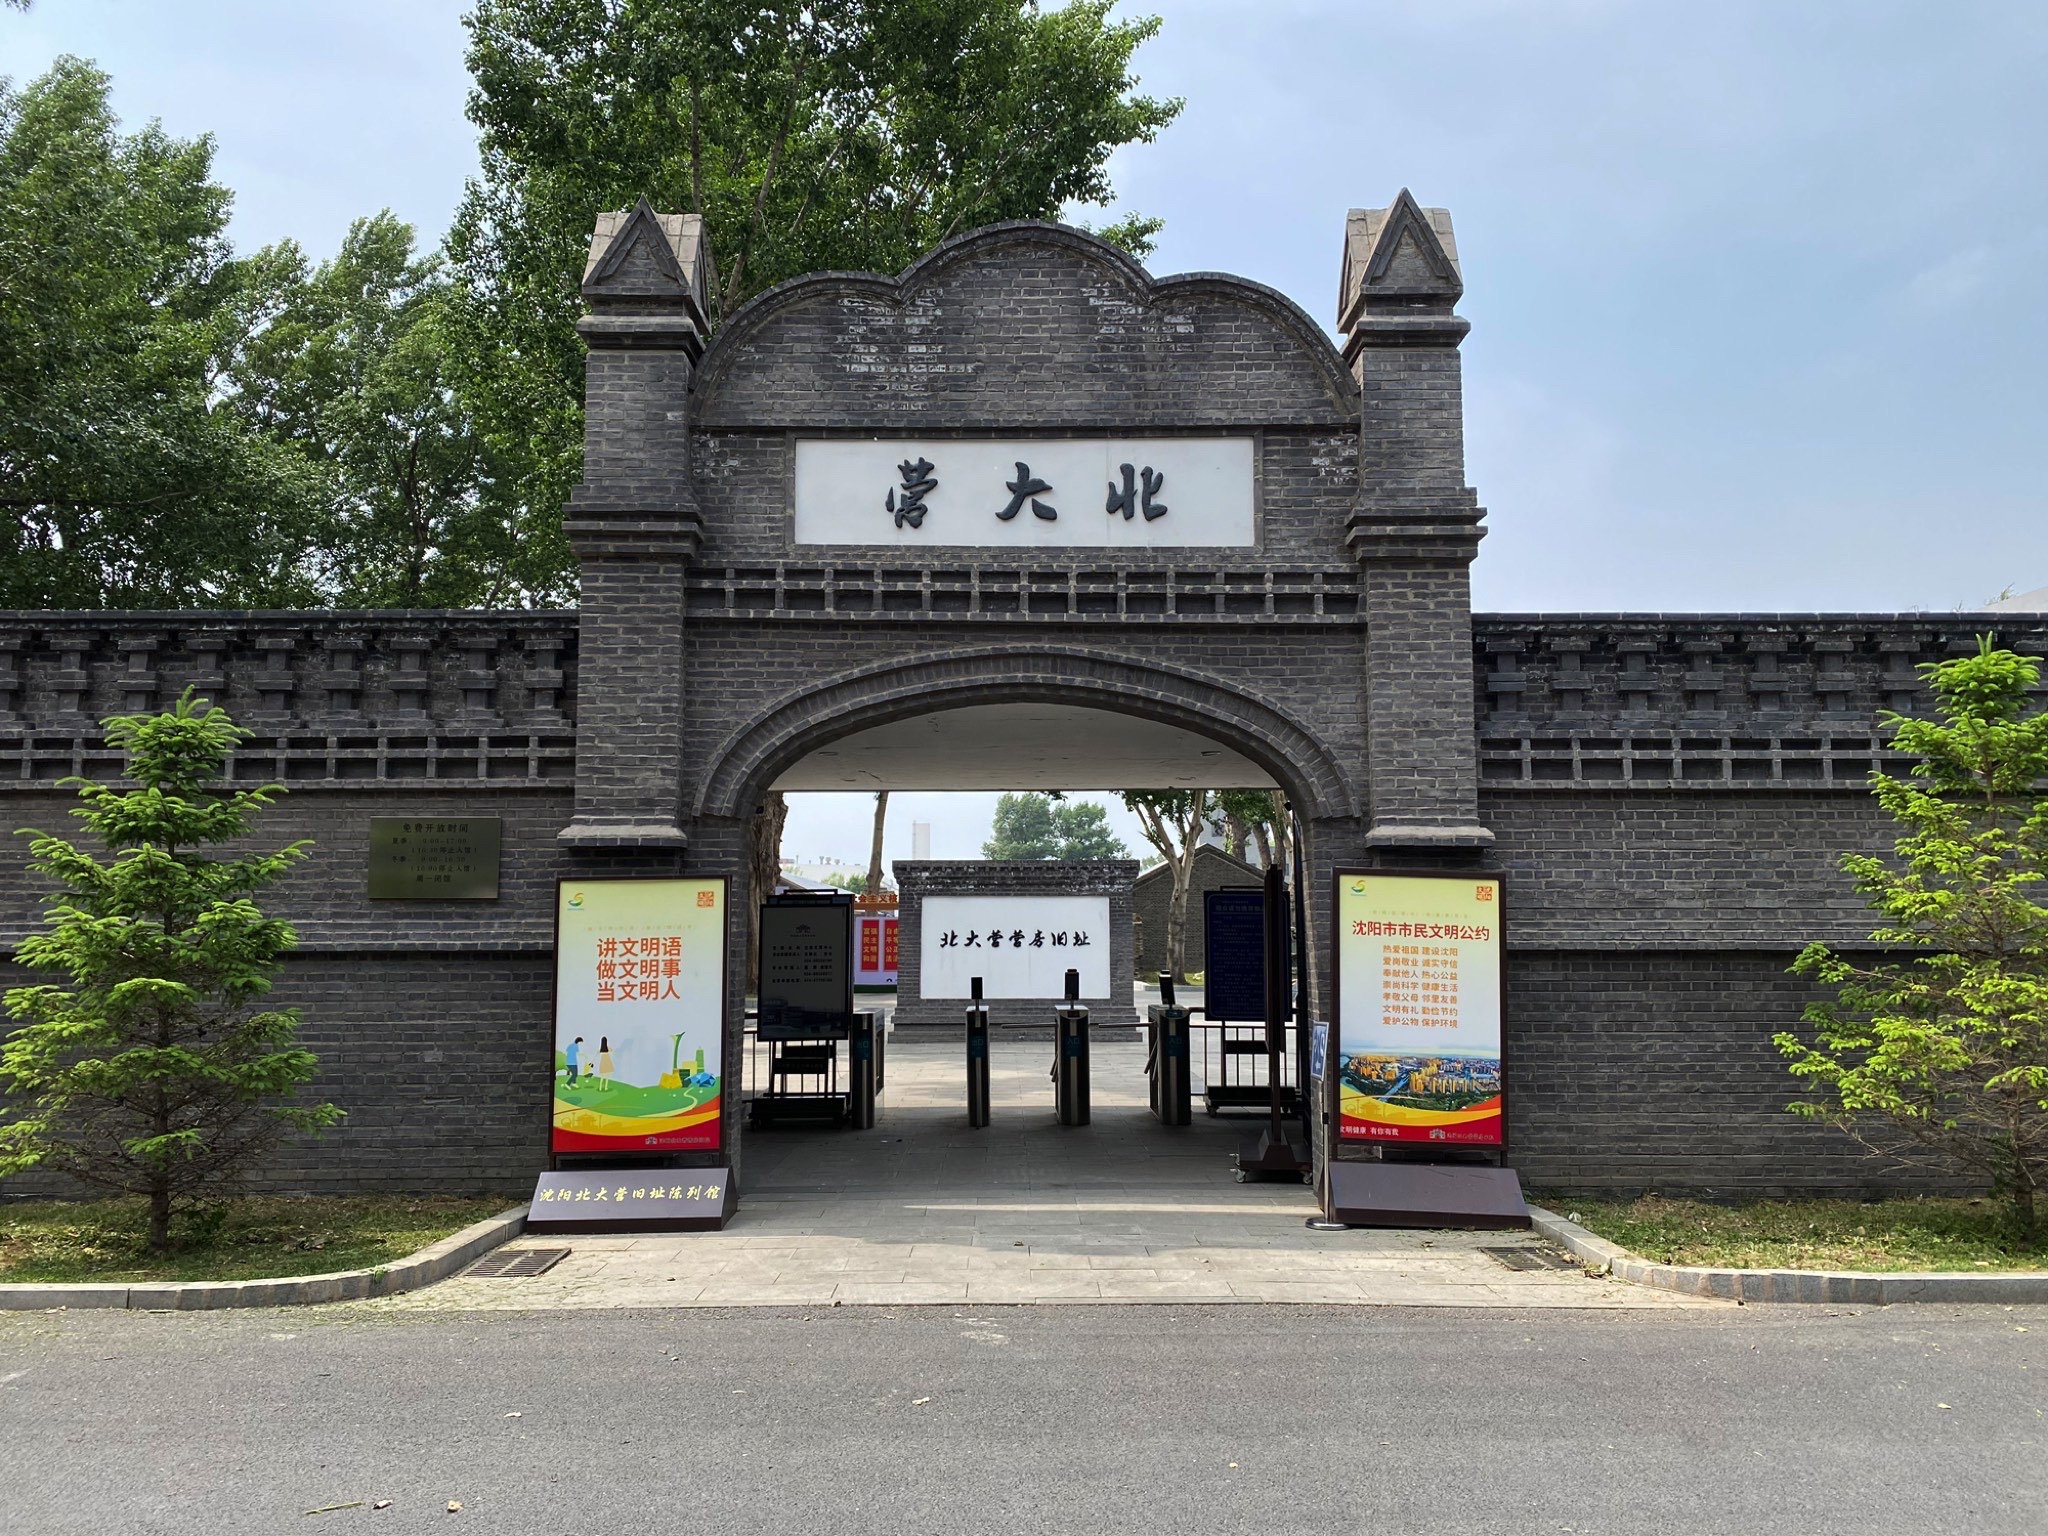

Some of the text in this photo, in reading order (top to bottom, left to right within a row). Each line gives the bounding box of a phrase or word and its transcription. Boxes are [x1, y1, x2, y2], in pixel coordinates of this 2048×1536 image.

[402, 823, 469, 834] 免费开放时间
[855, 893, 898, 903] 会主义核
[1352, 920, 1490, 941] 沈阳市市民文明公约
[939, 929, 1091, 948] 北大营营房旧址
[596, 937, 682, 958] 讲文明语
[1382, 945, 1458, 956] 热爱祖国 建设沈阳
[1382, 957, 1458, 968] 爱岗敬业 诚实守信
[596, 958, 682, 980] 做文明事
[1382, 969, 1458, 981] 奉献他人 热心公益
[596, 980, 681, 1002] 当文明人
[1382, 981, 1458, 992] 崇尚科学 健康生活
[1382, 992, 1458, 1004] 孝敬父母 邻里友善
[1382, 1004, 1419, 1014] 文明有礼
[1382, 1016, 1458, 1028] 爱护公物 保护环境
[1340, 1126, 1400, 1136] 文明健康 有你有我
[540, 1185, 722, 1202] 沈阳北大营旧址陈列馆
